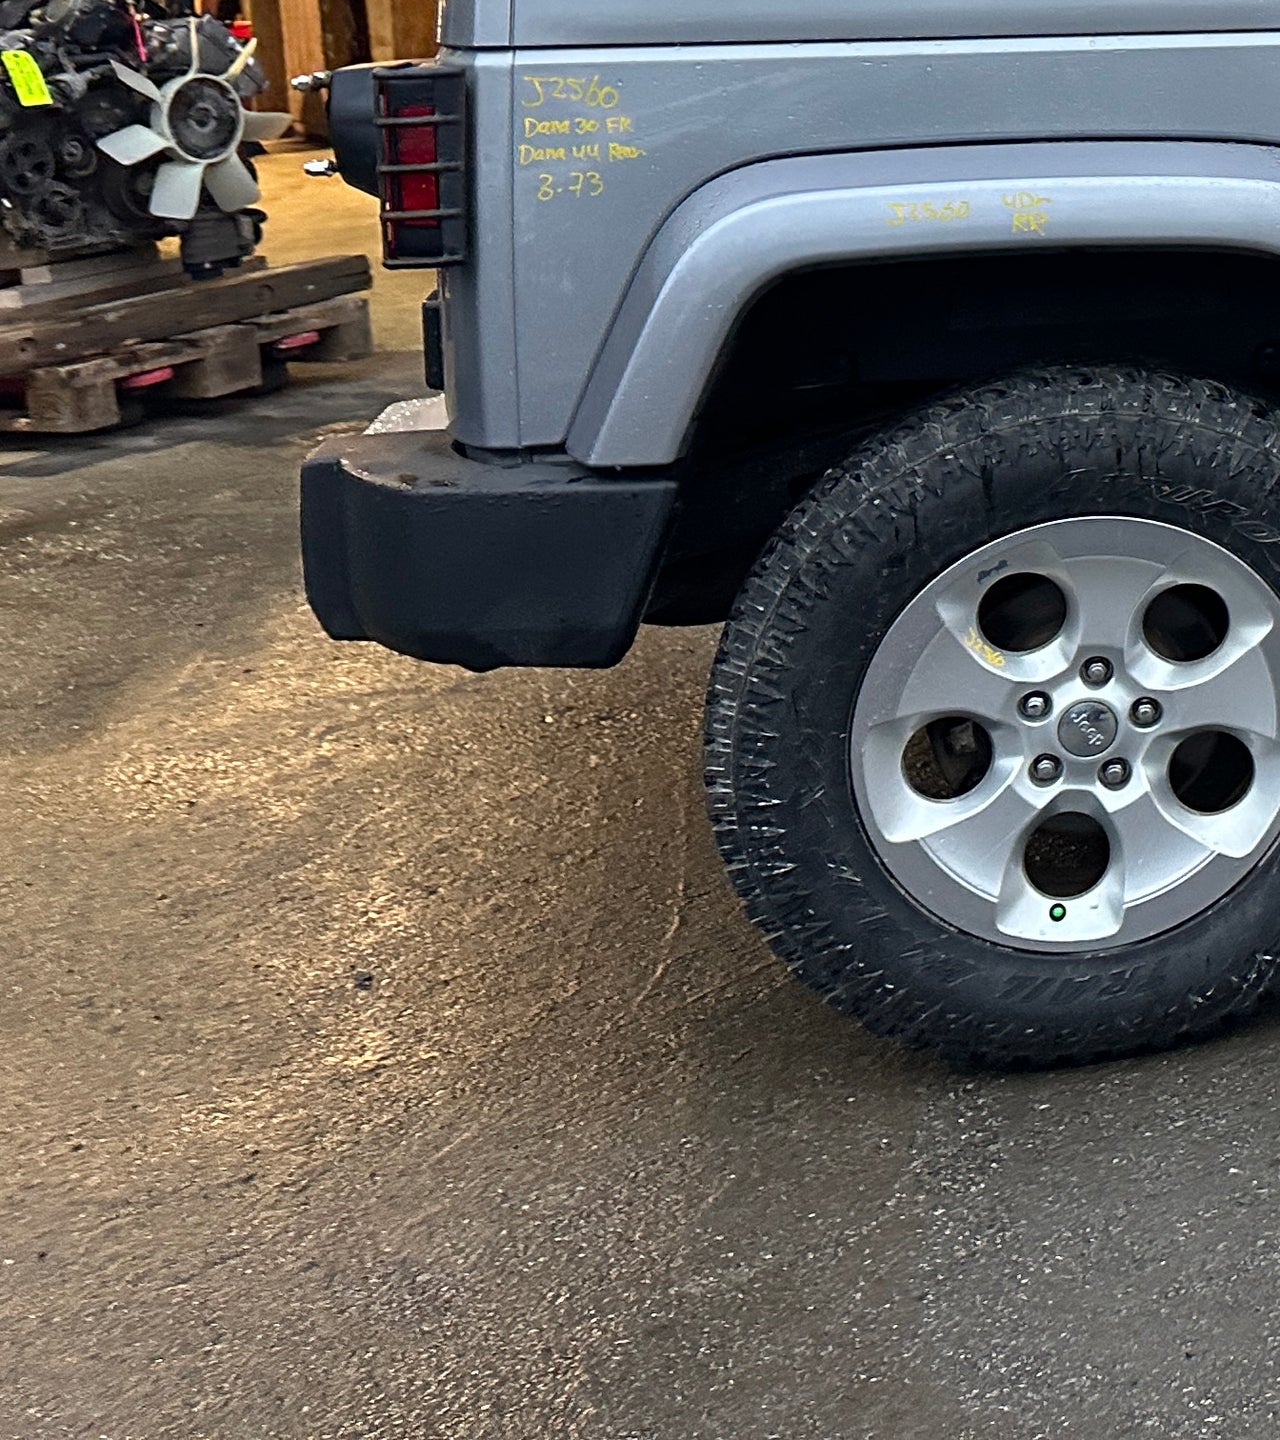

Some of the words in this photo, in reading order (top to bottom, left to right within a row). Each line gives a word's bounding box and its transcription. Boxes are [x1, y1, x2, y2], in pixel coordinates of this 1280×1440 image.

[521, 74, 620, 108] J2560
[523, 117, 571, 138] Dana
[573, 117, 599, 135] 30
[518, 143, 567, 166] Dana
